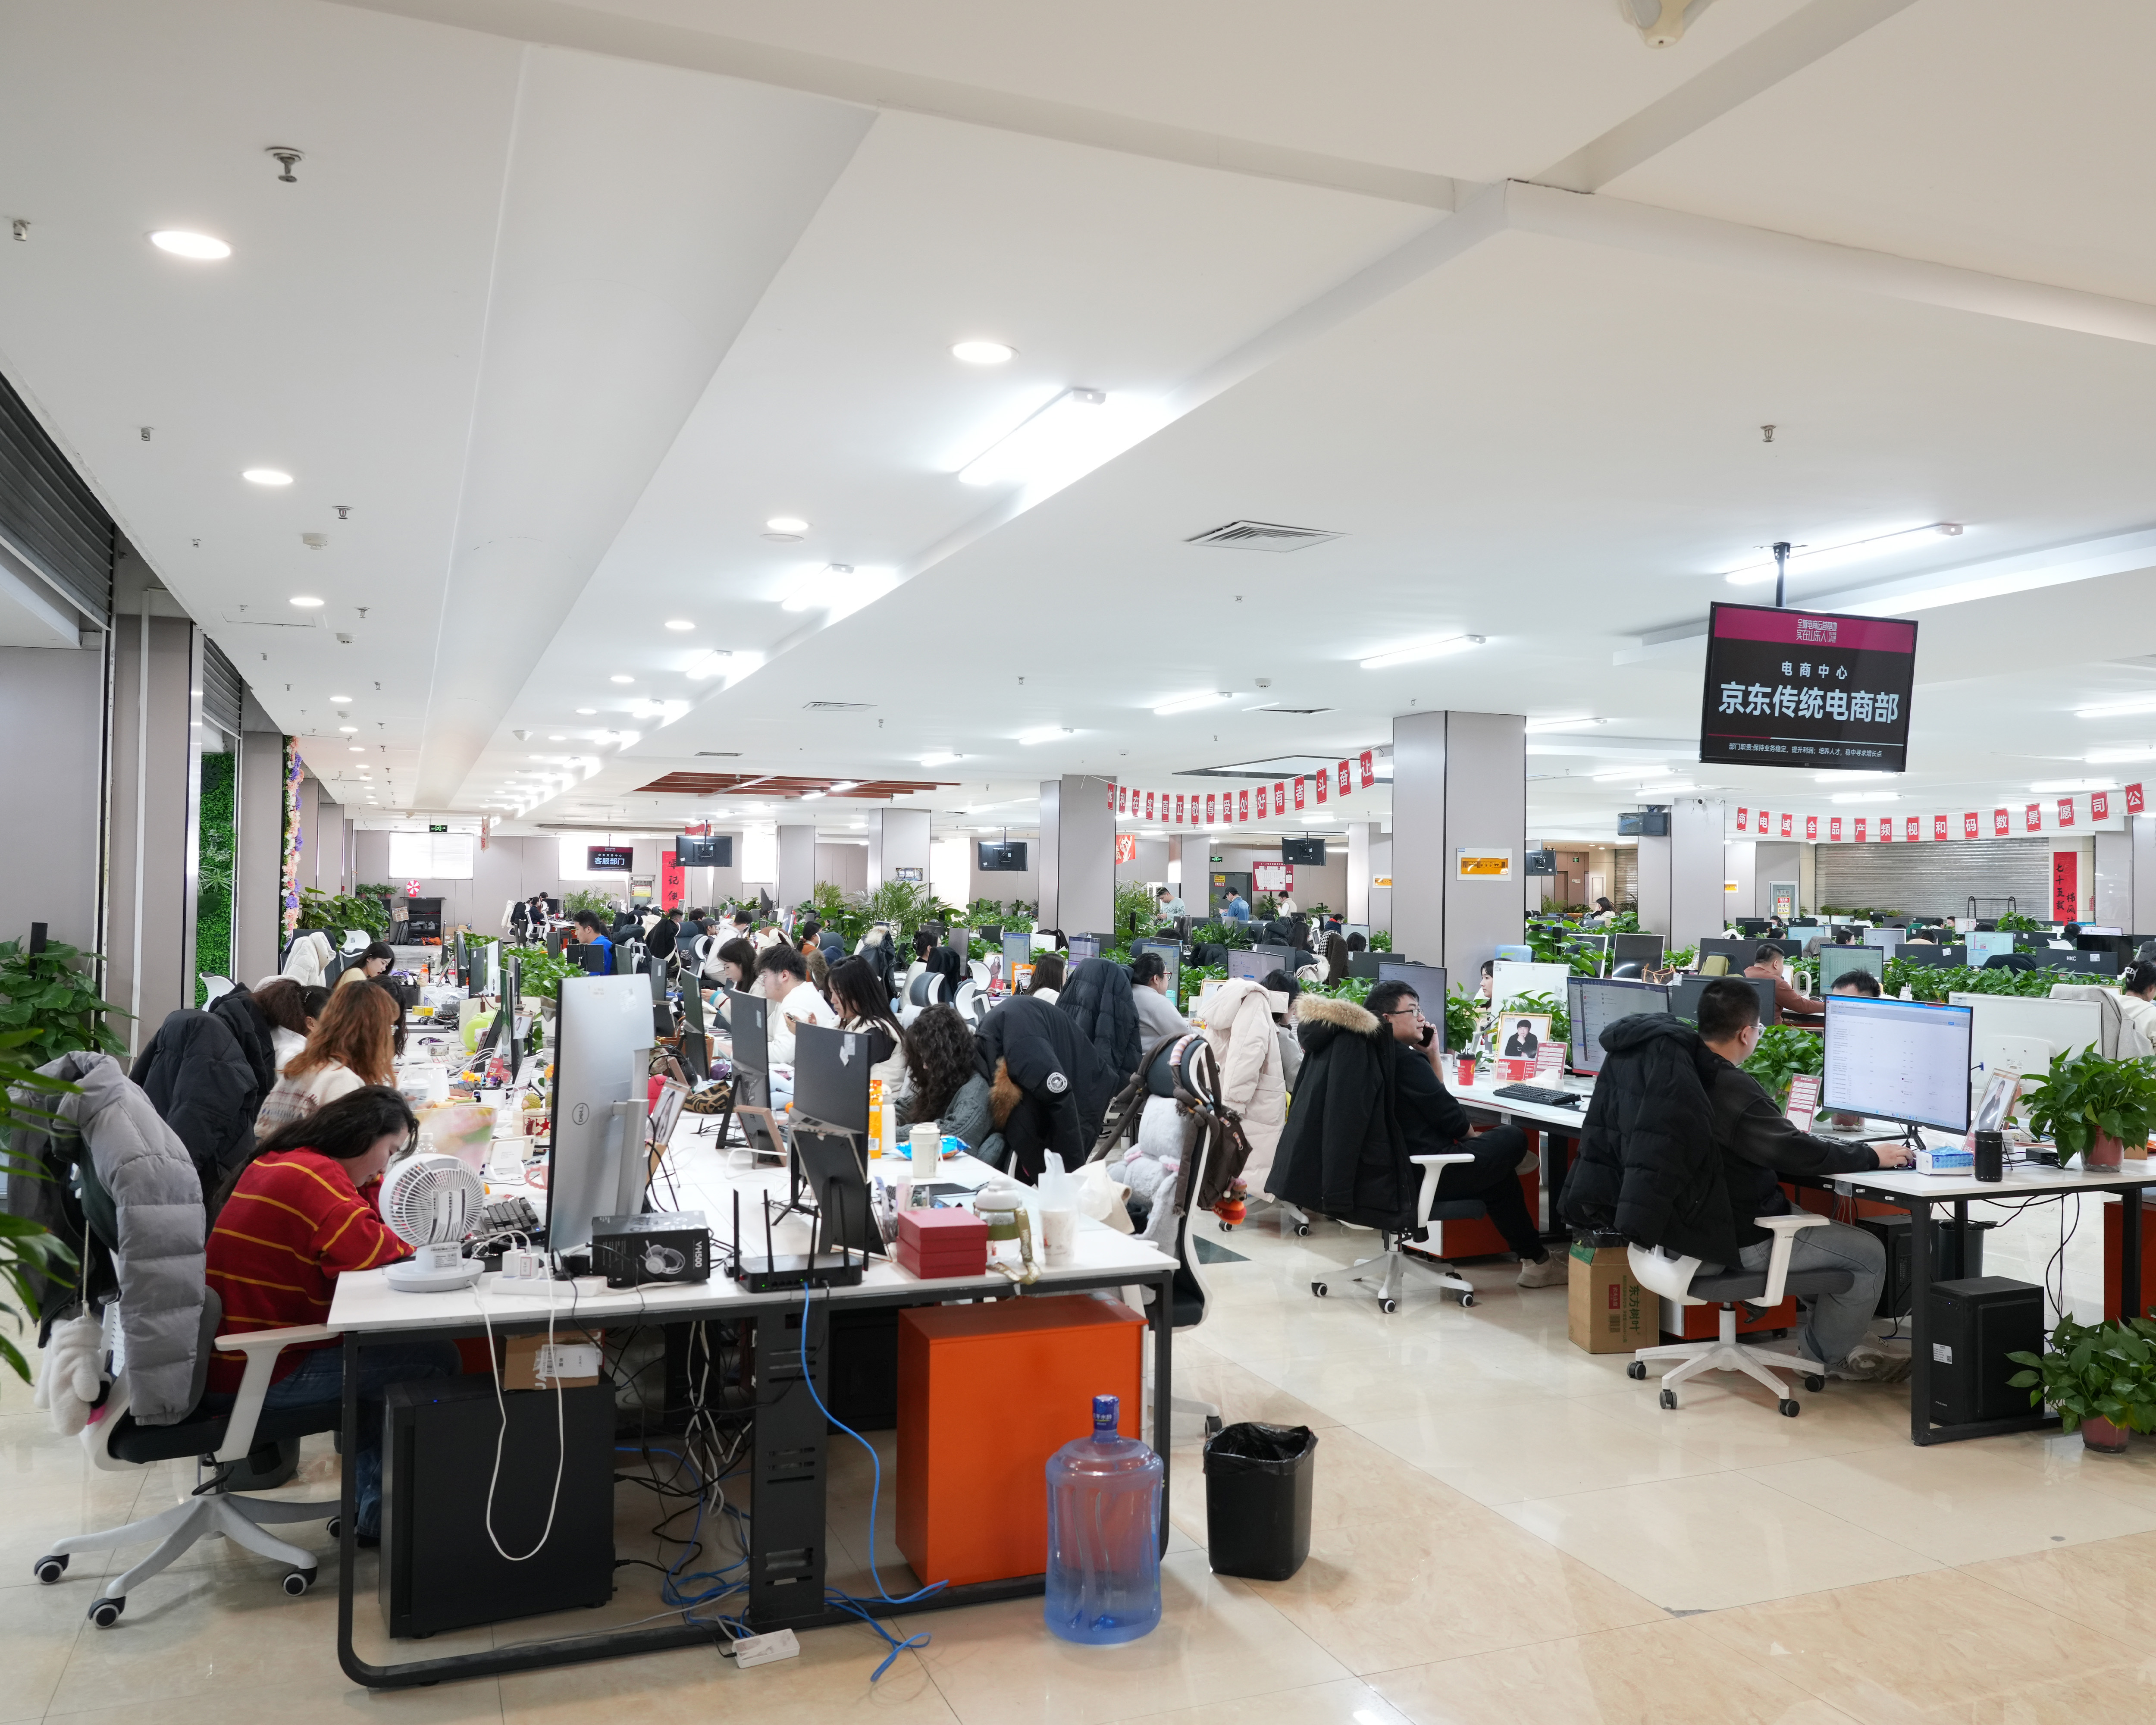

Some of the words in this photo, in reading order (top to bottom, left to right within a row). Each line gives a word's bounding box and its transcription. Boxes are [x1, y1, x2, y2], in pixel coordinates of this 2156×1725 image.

[1796, 629, 1827, 643] 实在山东人
[1797, 619, 1837, 631] 全域电商运营基地
[1781, 661, 1848, 680] 电商中心
[1718, 681, 1899, 724] 京东传统电商部
[2056, 863, 2065, 910] 七十五载
[1629, 1285, 1640, 1332] 东方树叶
